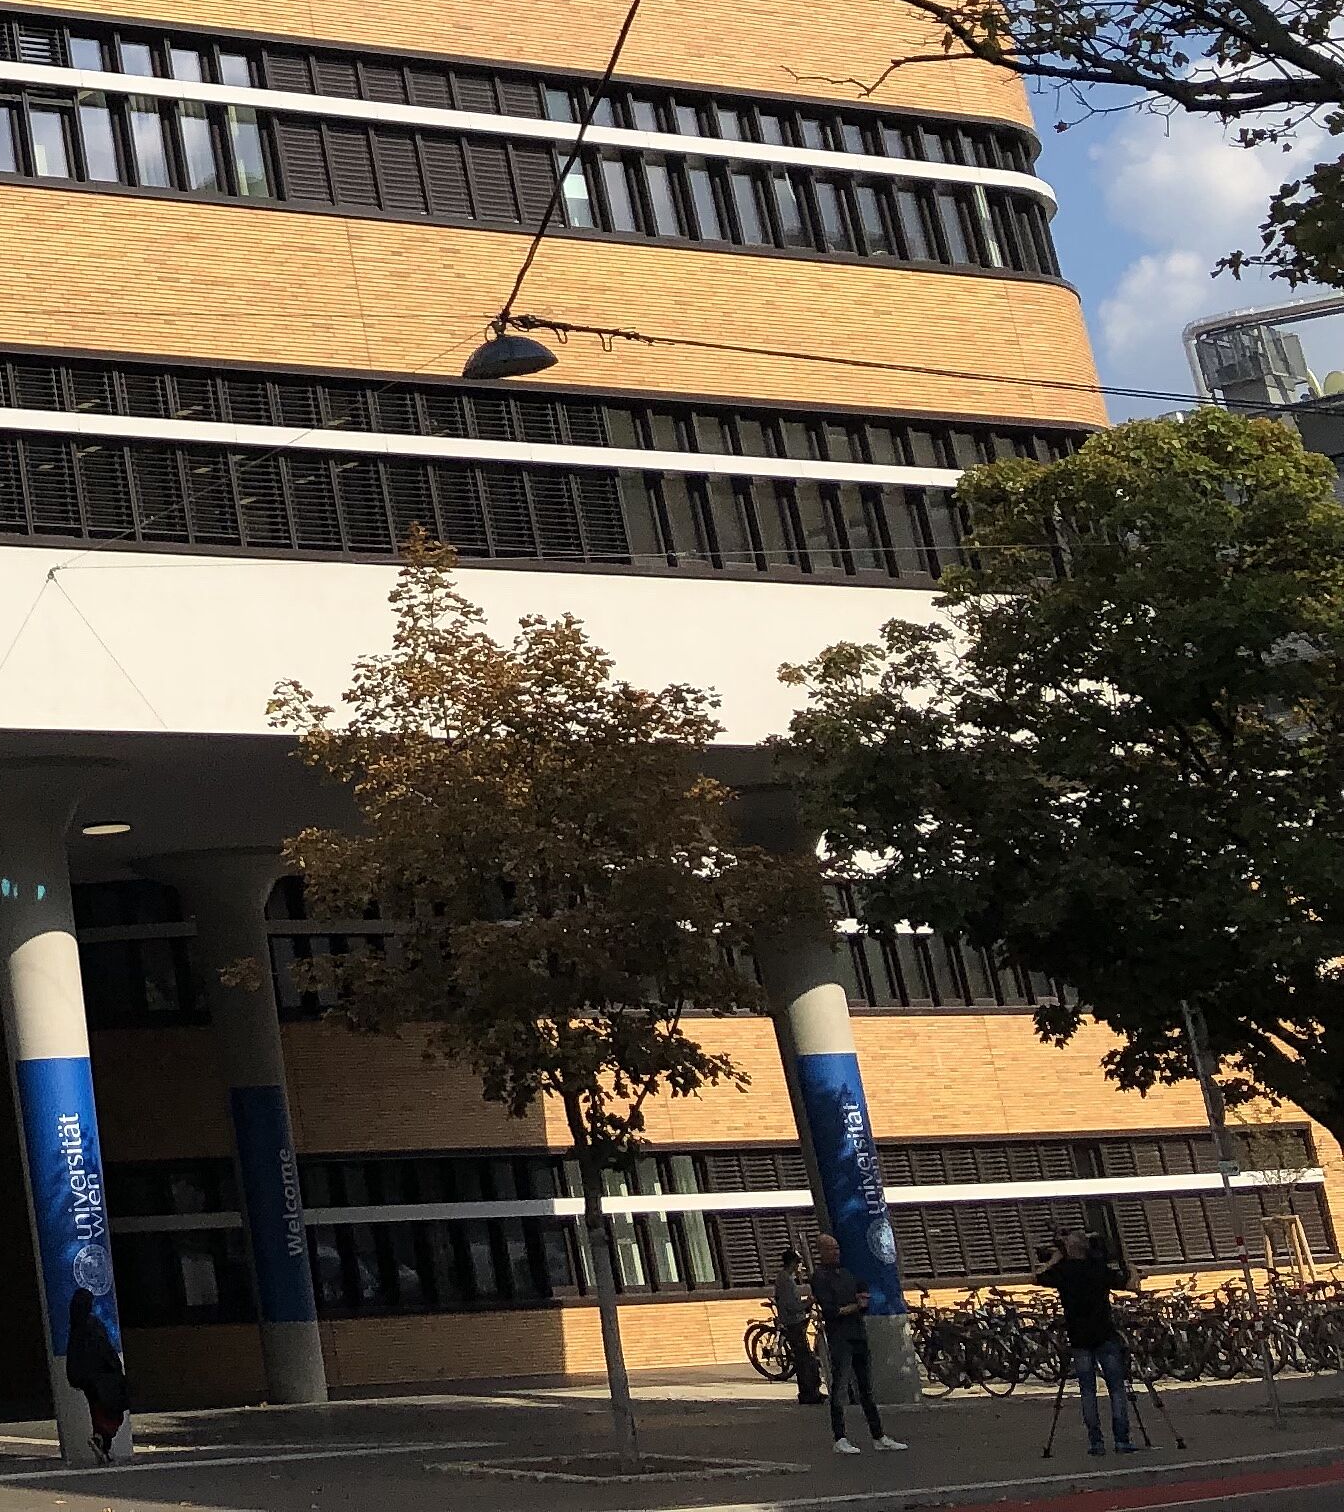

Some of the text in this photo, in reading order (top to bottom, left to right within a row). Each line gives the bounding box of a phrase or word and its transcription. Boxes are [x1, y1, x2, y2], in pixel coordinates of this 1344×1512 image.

[58, 1112, 93, 1240] universität
[87, 1173, 105, 1238] wien
[279, 1148, 303, 1256] Welcome
[842, 1102, 881, 1215] universität
